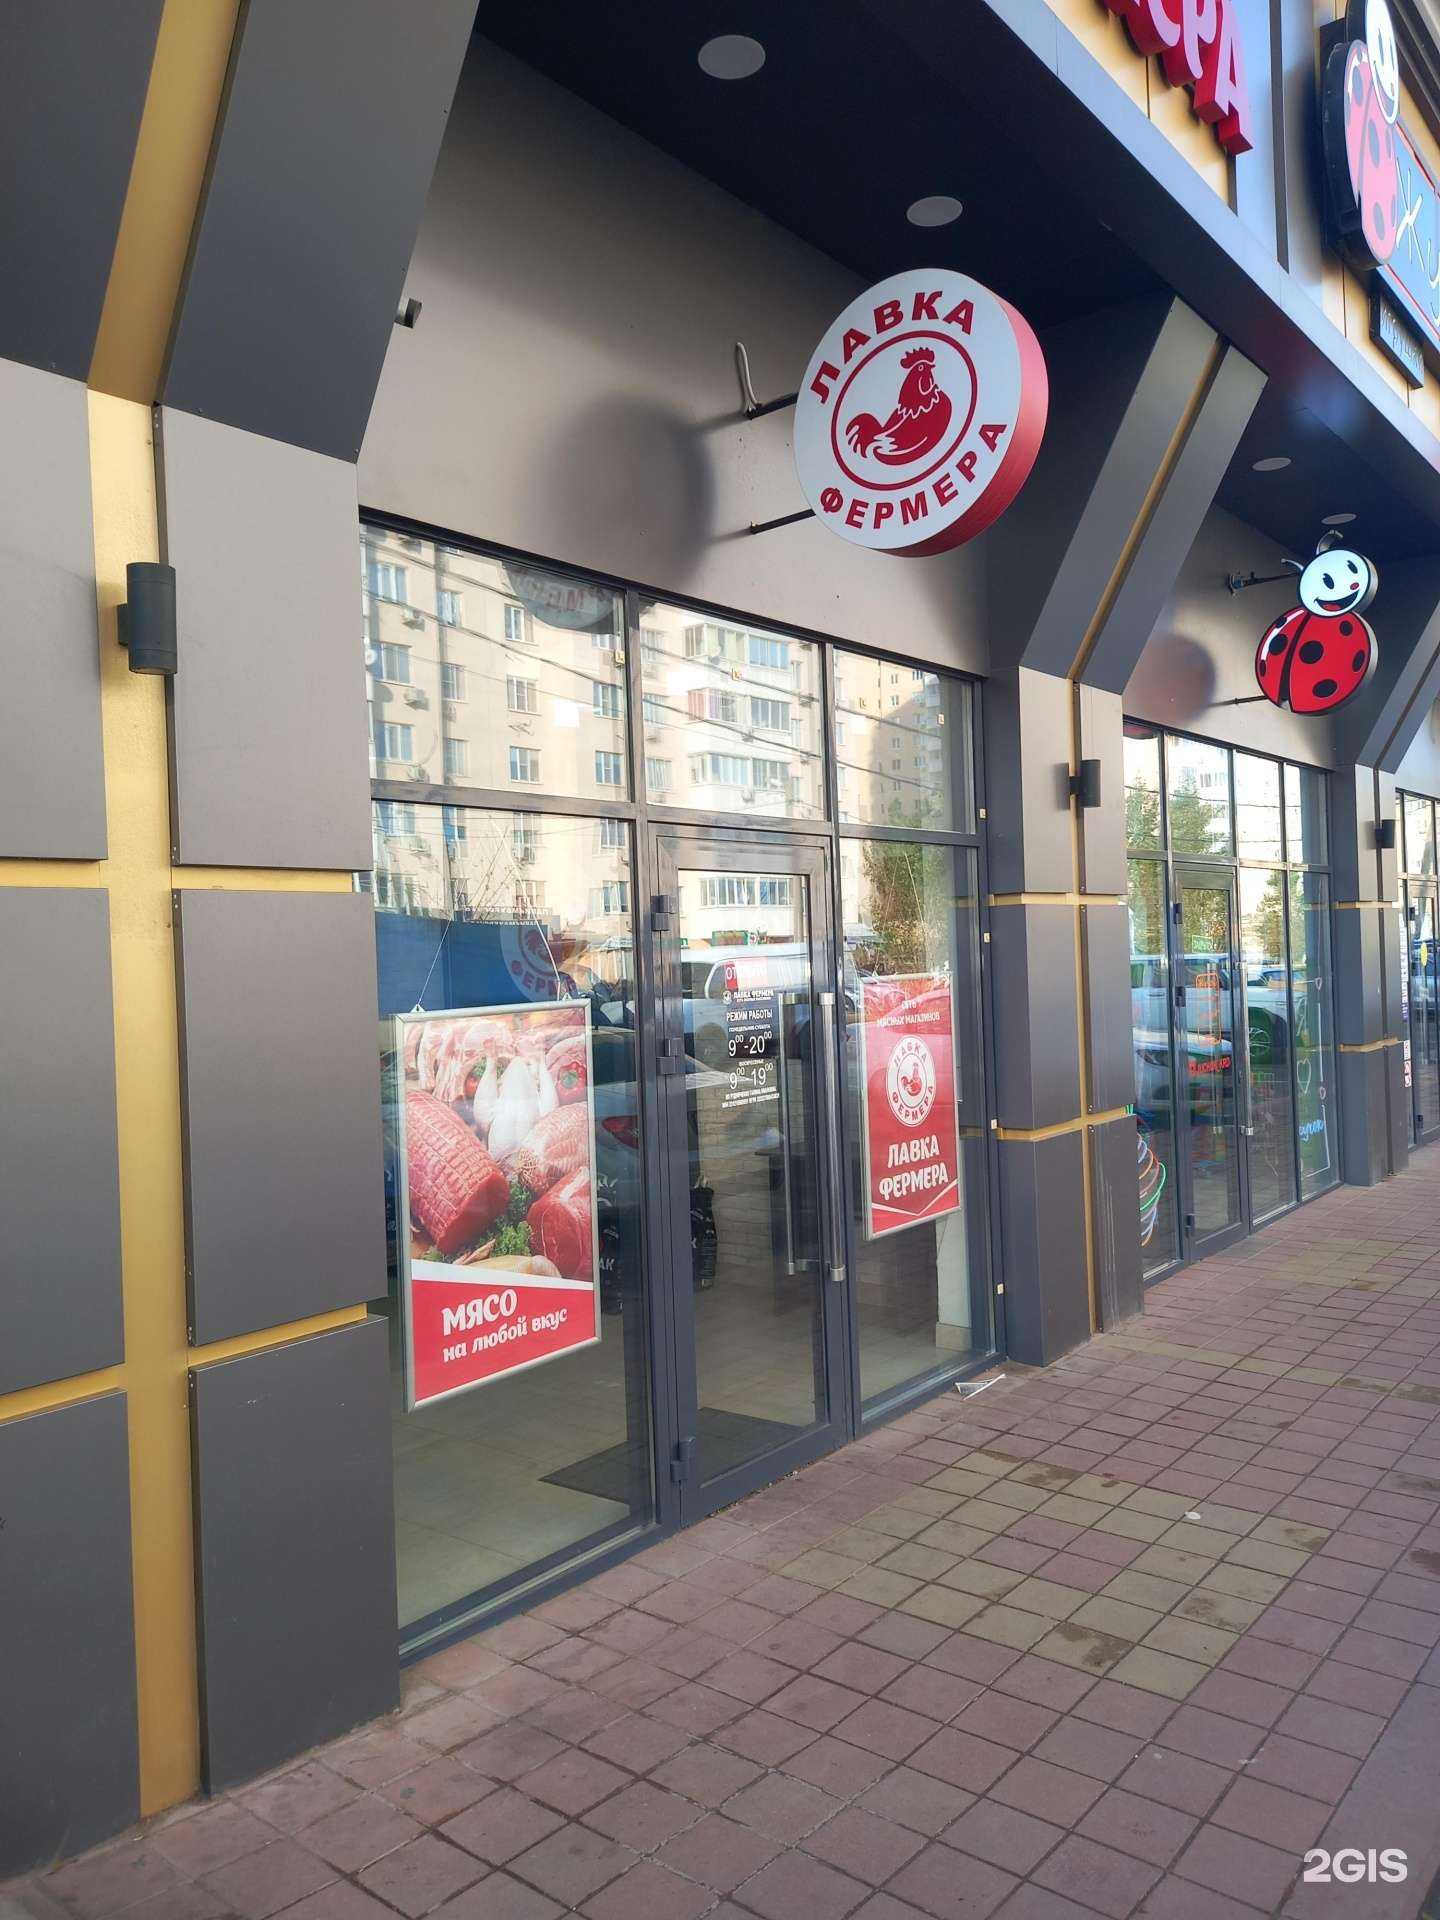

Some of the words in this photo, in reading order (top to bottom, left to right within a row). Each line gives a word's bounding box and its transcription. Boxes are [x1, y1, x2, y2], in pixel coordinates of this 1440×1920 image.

[810, 291, 975, 405] ЛАВКА
[819, 424, 1008, 530] ФЕРМЕРА
[726, 1011, 748, 1022] РЕЖИМ
[748, 1008, 773, 1020] РАБОТЫ
[892, 1085, 934, 1121] ФЕРМЕРА
[887, 1134, 940, 1168] ЛАВКА
[878, 1162, 949, 1201] ФЕРМЕРА
[441, 1288, 518, 1336] МЯСО
[442, 1341, 468, 1363] на
[471, 1314, 528, 1354] любой
[531, 1308, 568, 1331] вкус
